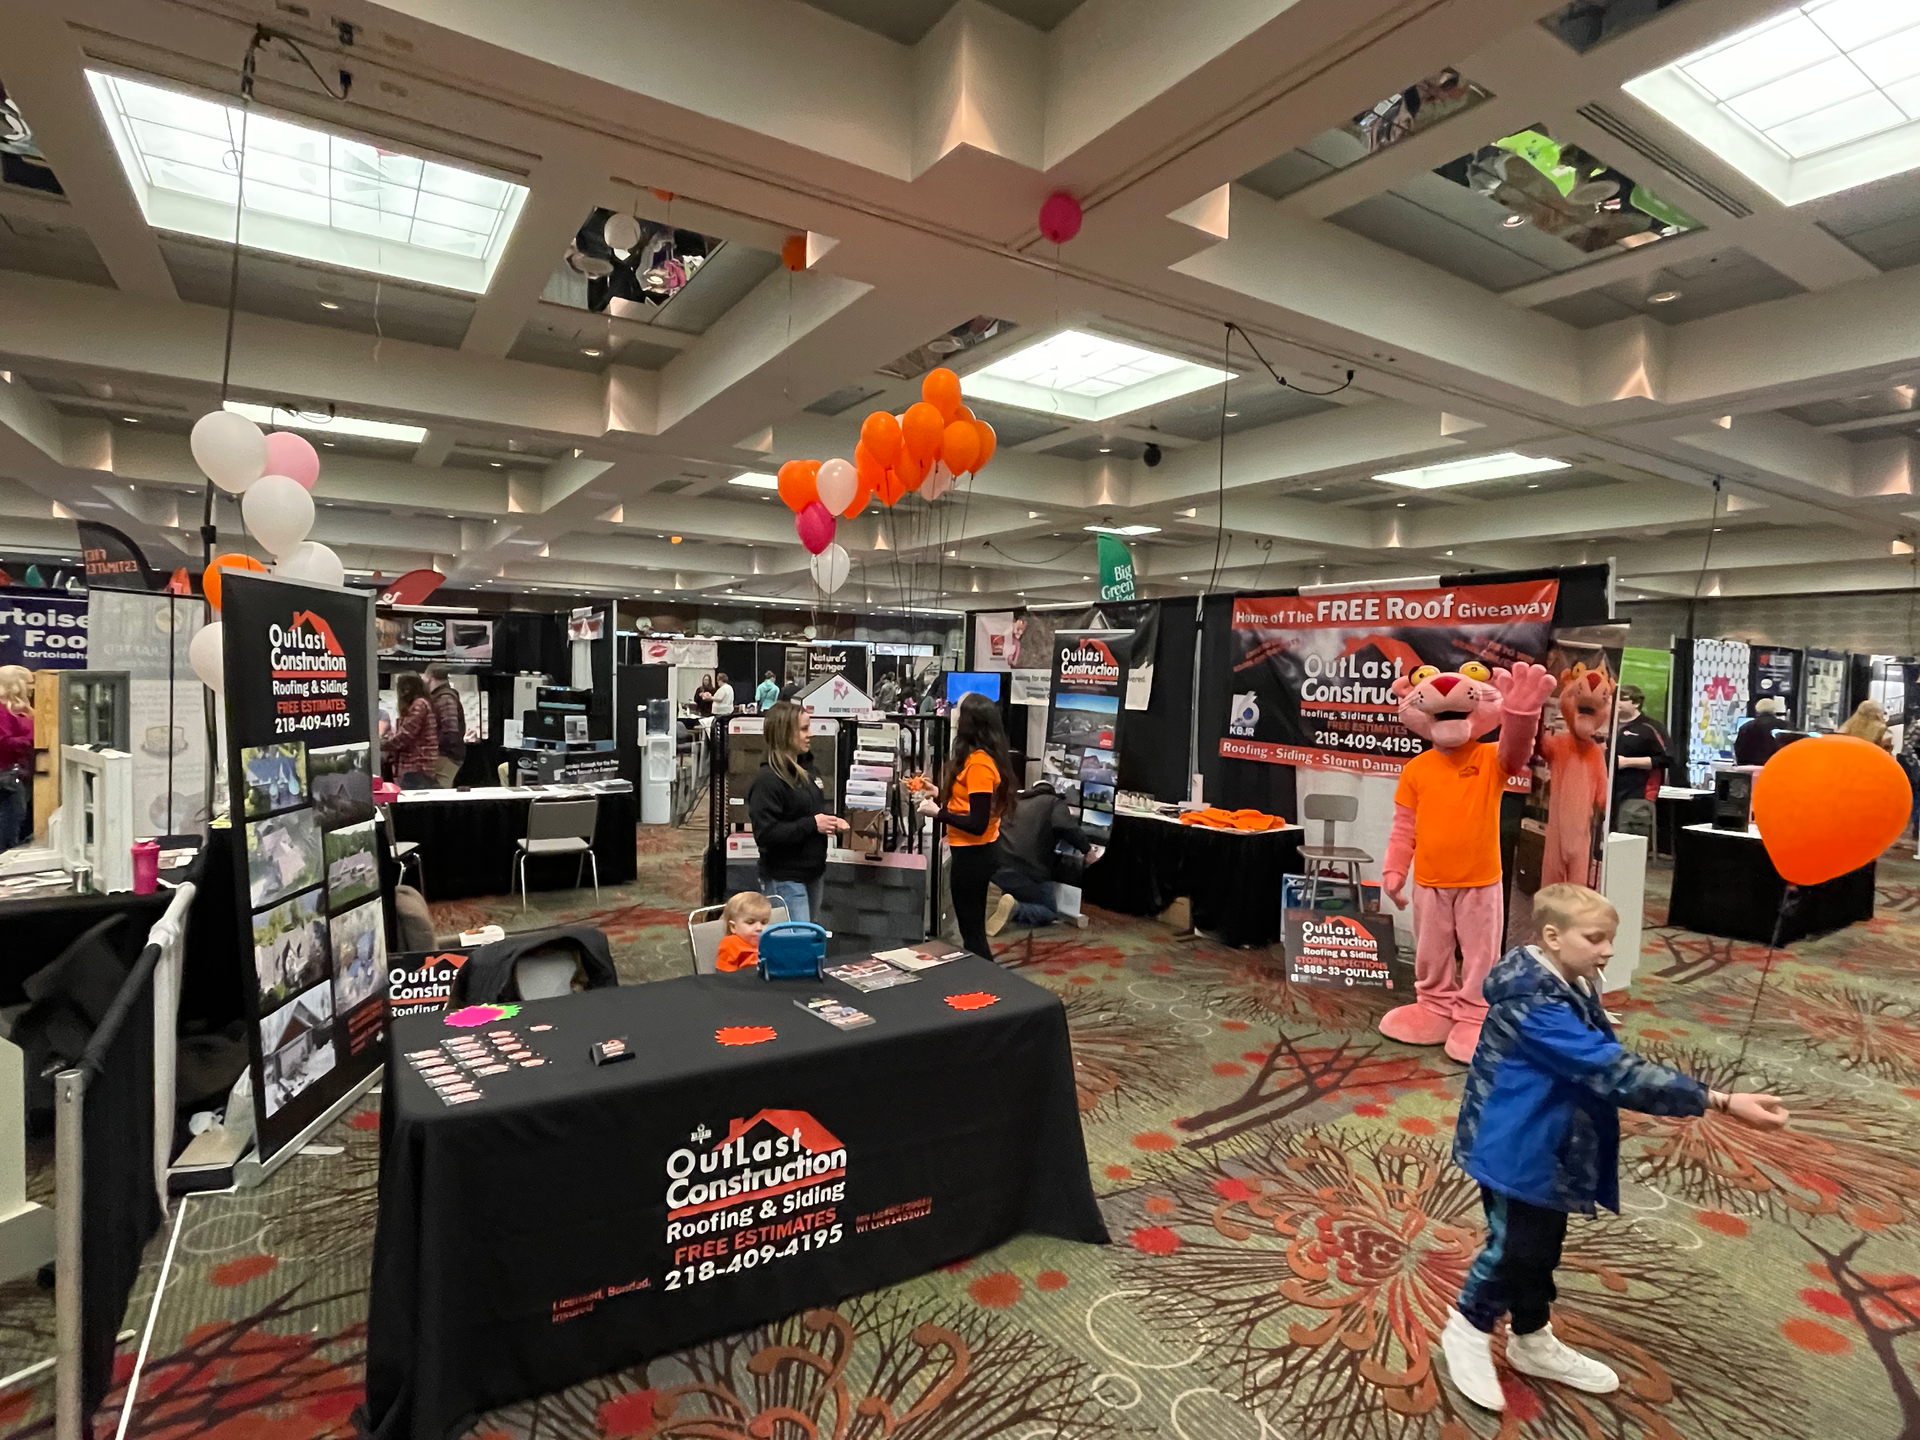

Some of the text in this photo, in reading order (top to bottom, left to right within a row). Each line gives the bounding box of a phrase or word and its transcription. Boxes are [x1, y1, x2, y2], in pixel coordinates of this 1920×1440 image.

[1114, 565, 1132, 581] Big
[1101, 580, 1134, 600] Green
[1236, 593, 1551, 623] Home of The FREE Roof Giveaway
[269, 623, 326, 649] OutLast
[271, 647, 347, 671] Construction
[809, 661, 846, 673] Lounger
[1304, 654, 1403, 679] OutLast
[1061, 661, 1119, 677] Construction
[272, 680, 349, 697] Roofing & Siding
[277, 699, 347, 714] FREE ESTIMATES
[275, 713, 350, 734] 218-409-4195
[1341, 711, 1374, 722] Siding
[1377, 713, 1385, 722] &
[1229, 726, 1254, 737] KBJR
[1327, 720, 1408, 735] FREE ESTIMATES
[1223, 742, 1268, 759] Roofing
[1276, 748, 1314, 765] Siding
[1322, 753, 1359, 769] Storm
[1302, 921, 1356, 936] OutLast
[1302, 933, 1377, 948] Construction
[1303, 947, 1378, 961] Roofing & Siding
[1295, 956, 1388, 970] STORM INSPECTIONS
[1293, 964, 1390, 980] 1-888-33-OUTLAST
[666, 1127, 802, 1180] OutLast
[666, 1148, 848, 1210] Construction
[667, 1205, 755, 1244] Roofing
[758, 1199, 778, 1220] &
[783, 1181, 846, 1214] Siding
[674, 1237, 729, 1266] FREE
[734, 1206, 837, 1250] ESTIMATES
[664, 1223, 844, 1292] 218-409-4195
